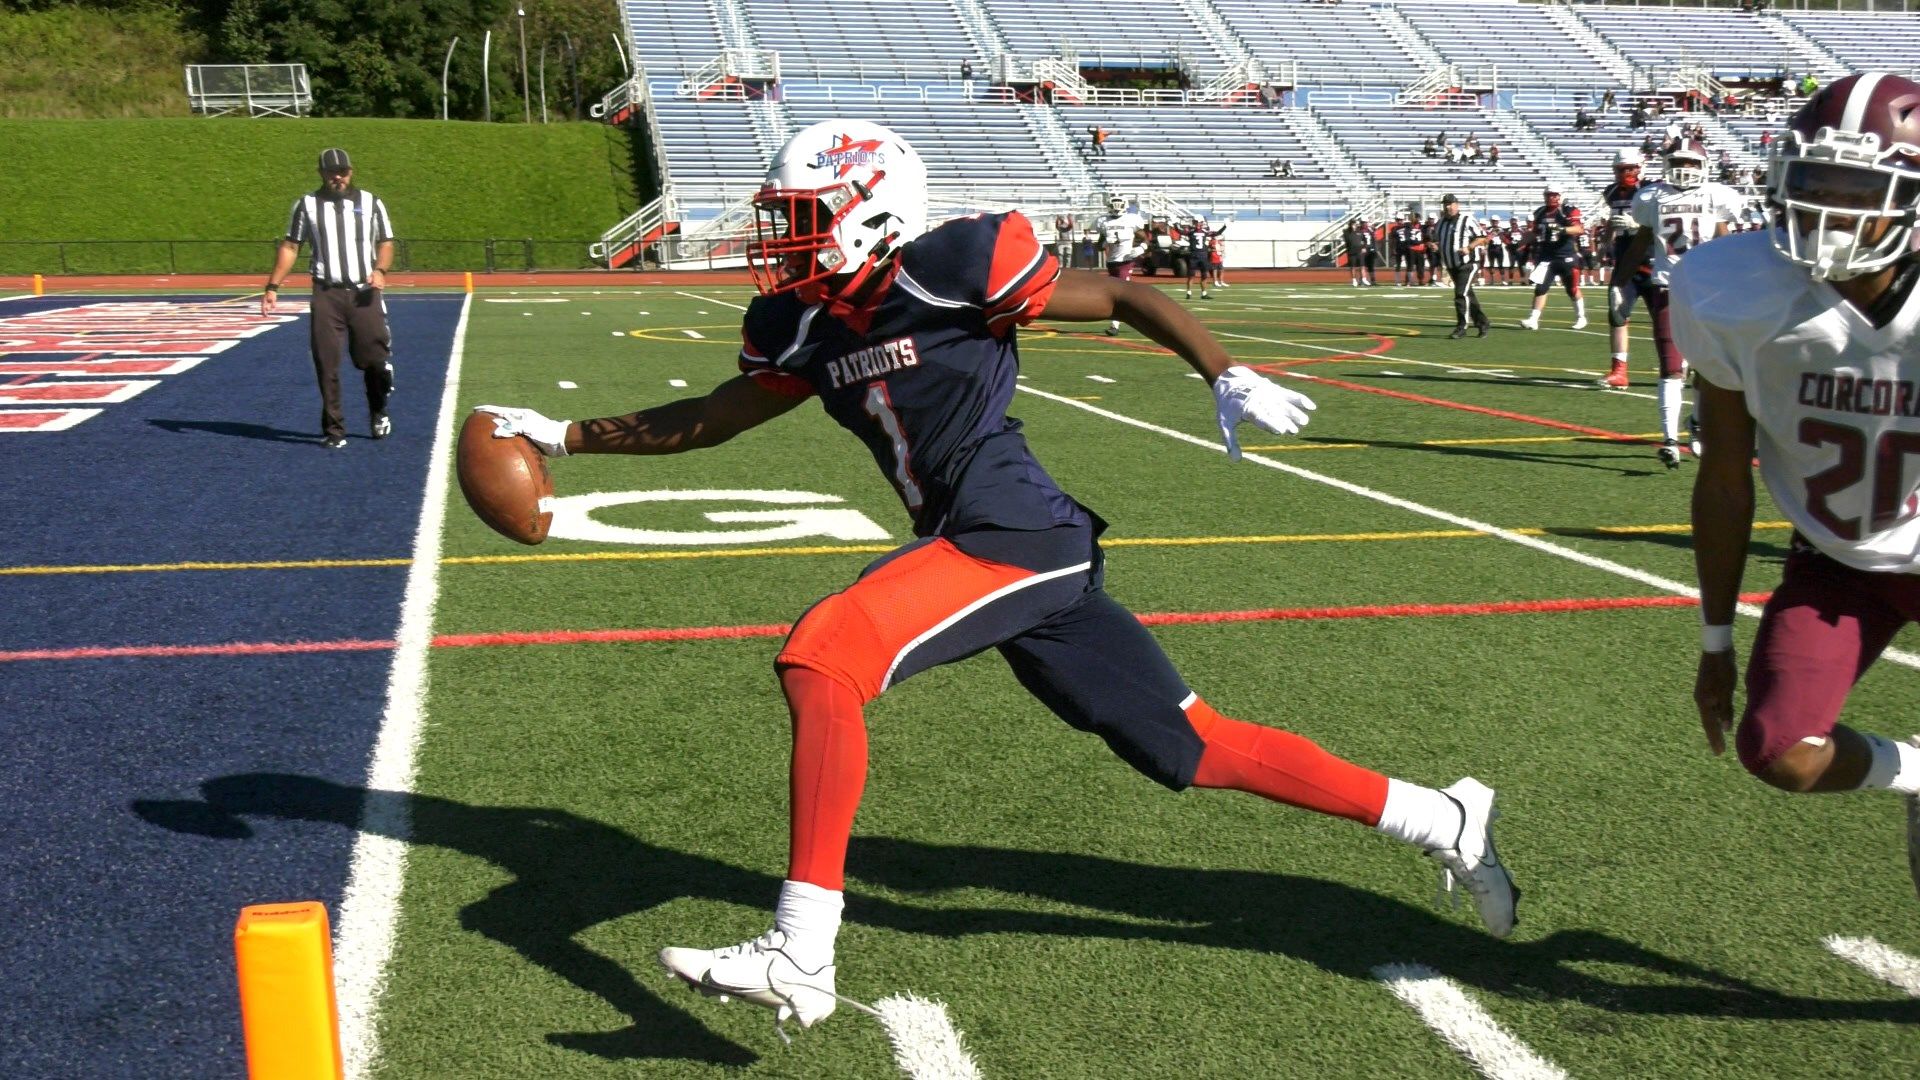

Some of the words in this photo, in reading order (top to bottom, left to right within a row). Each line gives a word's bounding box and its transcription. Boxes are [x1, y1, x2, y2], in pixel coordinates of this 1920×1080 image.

[817, 151, 885, 167] PATRIOTS
[1663, 217, 1700, 255] 21
[826, 336, 920, 389] PATRIOTS
[1799, 372, 1920, 417] CORCOR
[864, 380, 922, 511] 1
